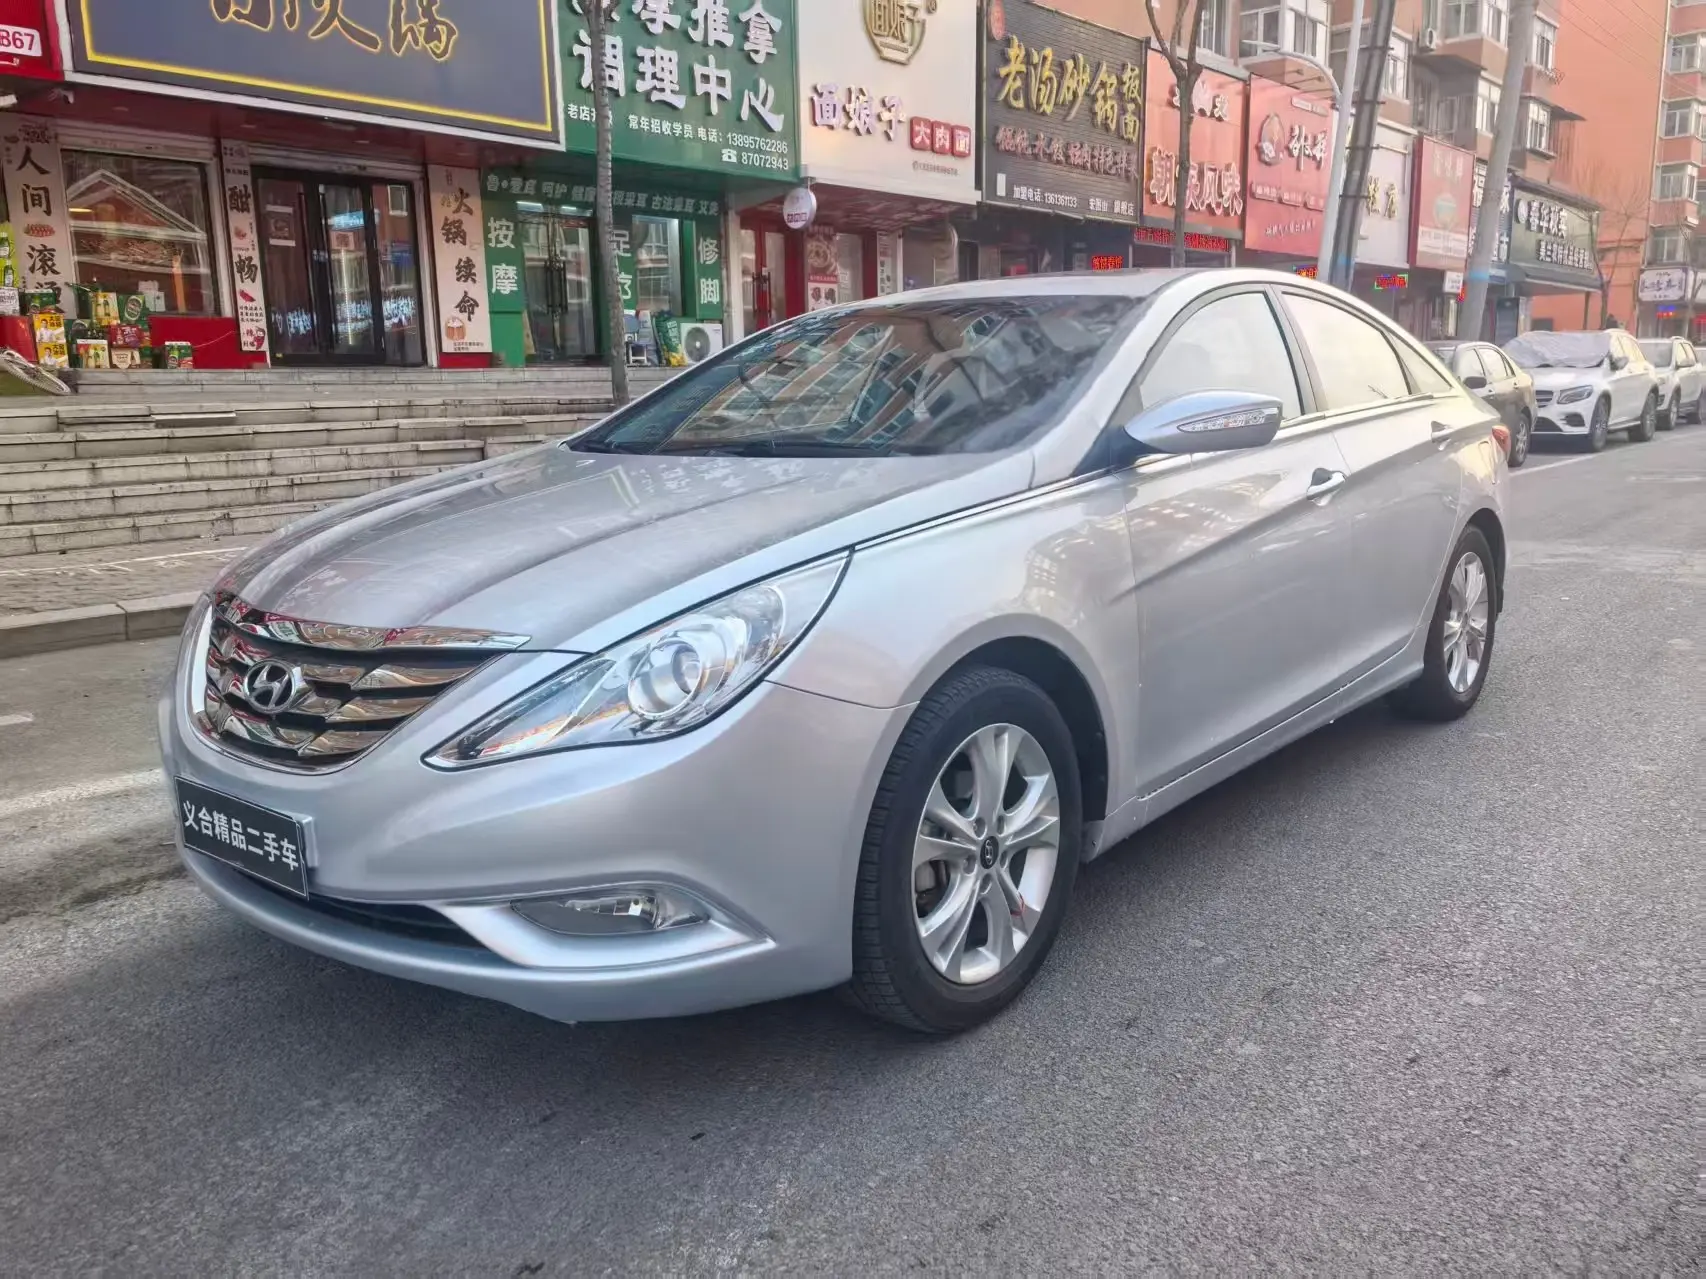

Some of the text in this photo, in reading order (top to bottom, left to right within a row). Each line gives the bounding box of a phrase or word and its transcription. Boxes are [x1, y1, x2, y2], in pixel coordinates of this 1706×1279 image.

[573, 29, 785, 132] 调理中心
[810, 83, 907, 141] 面娘子
[628, 113, 694, 139] 常年招收学员
[912, 118, 970, 156] 大肉面
[741, 151, 789, 170] 87072943
[441, 187, 479, 322] 火锅续命
[487, 217, 519, 295] 按摩
[698, 236, 721, 304] 修脚
[182, 801, 299, 871] 义合精品二手车
